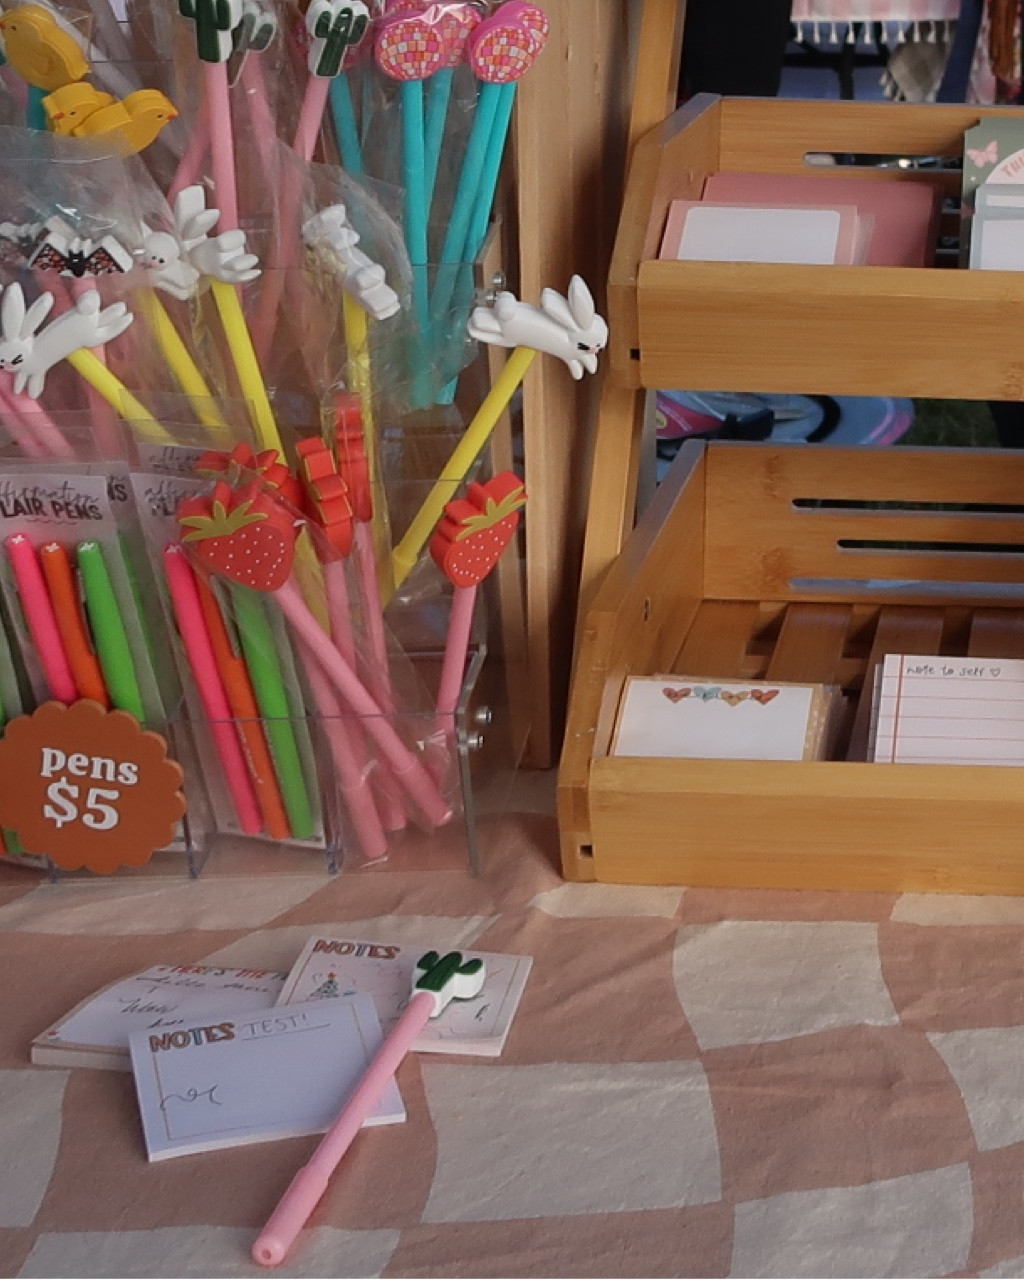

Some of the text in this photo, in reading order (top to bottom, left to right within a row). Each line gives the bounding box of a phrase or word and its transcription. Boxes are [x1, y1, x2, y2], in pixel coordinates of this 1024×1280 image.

[0, 497, 104, 521] LAIR PENS
[906, 664, 986, 677] note to self
[40, 747, 140, 787] pens
[43, 776, 121, 830] $5
[313, 939, 401, 960] NOTES
[149, 1022, 235, 1053] NOTES
